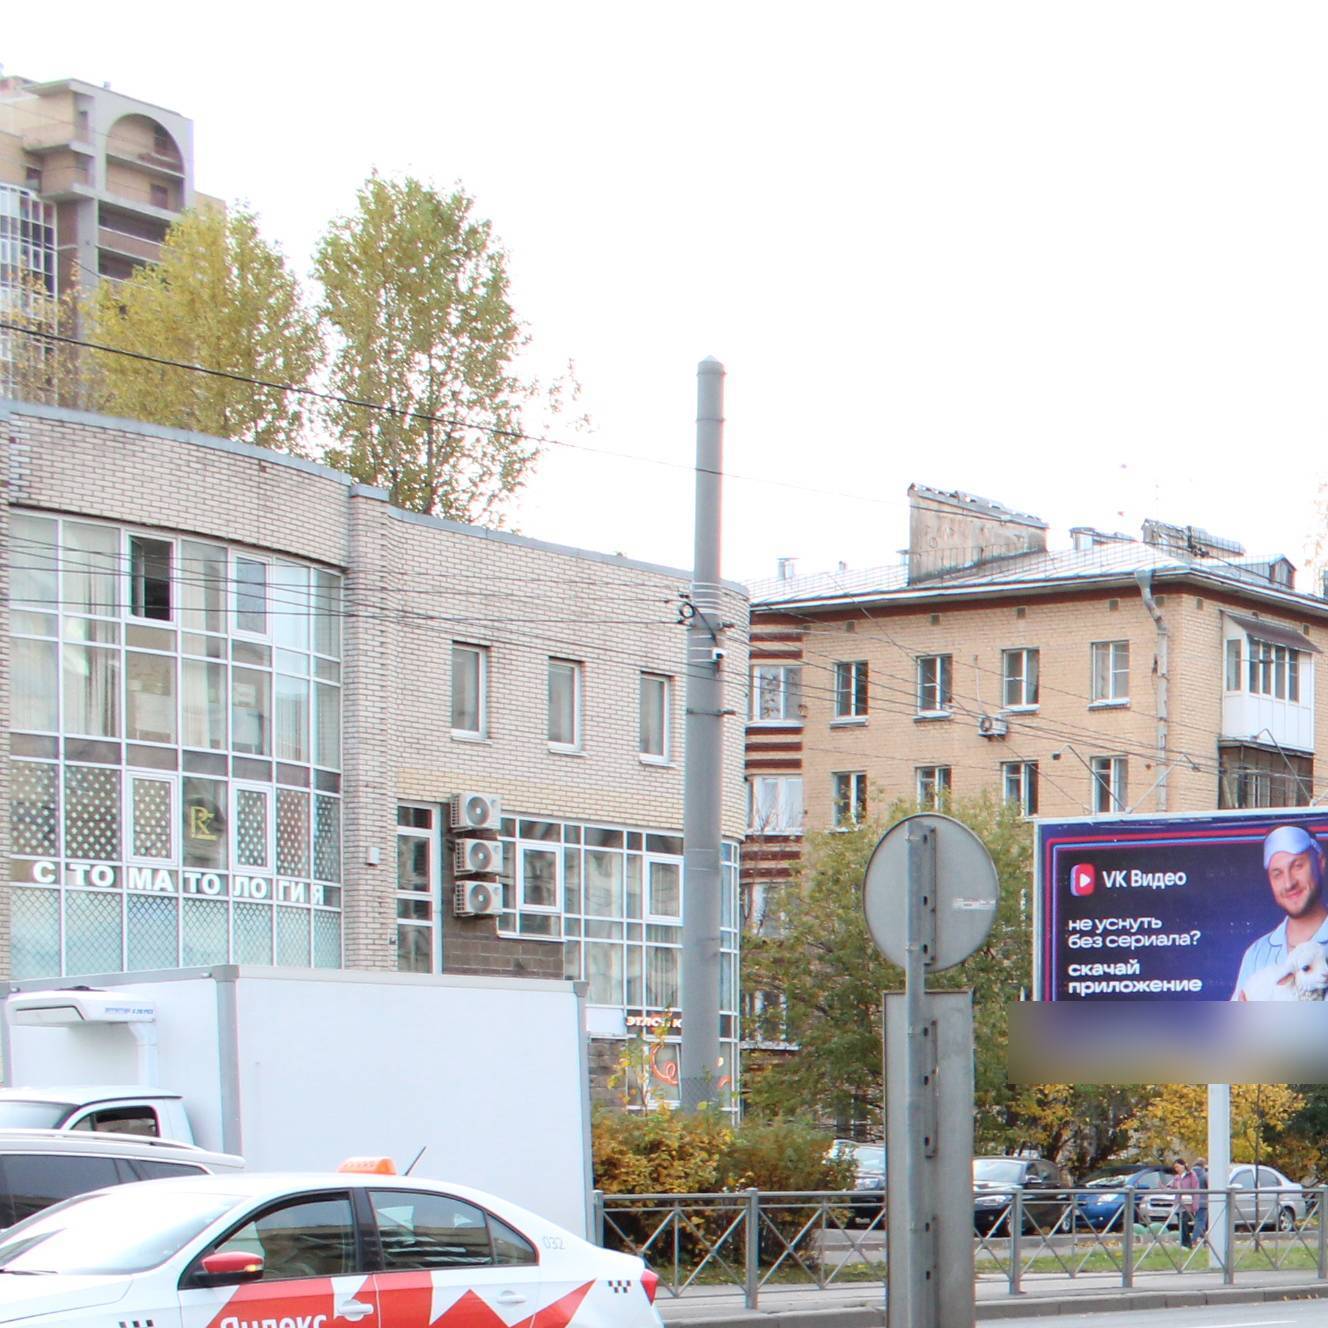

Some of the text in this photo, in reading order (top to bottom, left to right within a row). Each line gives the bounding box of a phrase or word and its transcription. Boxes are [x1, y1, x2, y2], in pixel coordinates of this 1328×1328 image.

[32, 861, 325, 904] СТОМАТОЛОГИЯ
[1102, 870, 1187, 890] VK Видео
[1068, 916, 1162, 934] не уснуть
[1068, 930, 1201, 950] без сериала?
[1068, 959, 1140, 977] скачай
[1068, 978, 1203, 996] приложение
